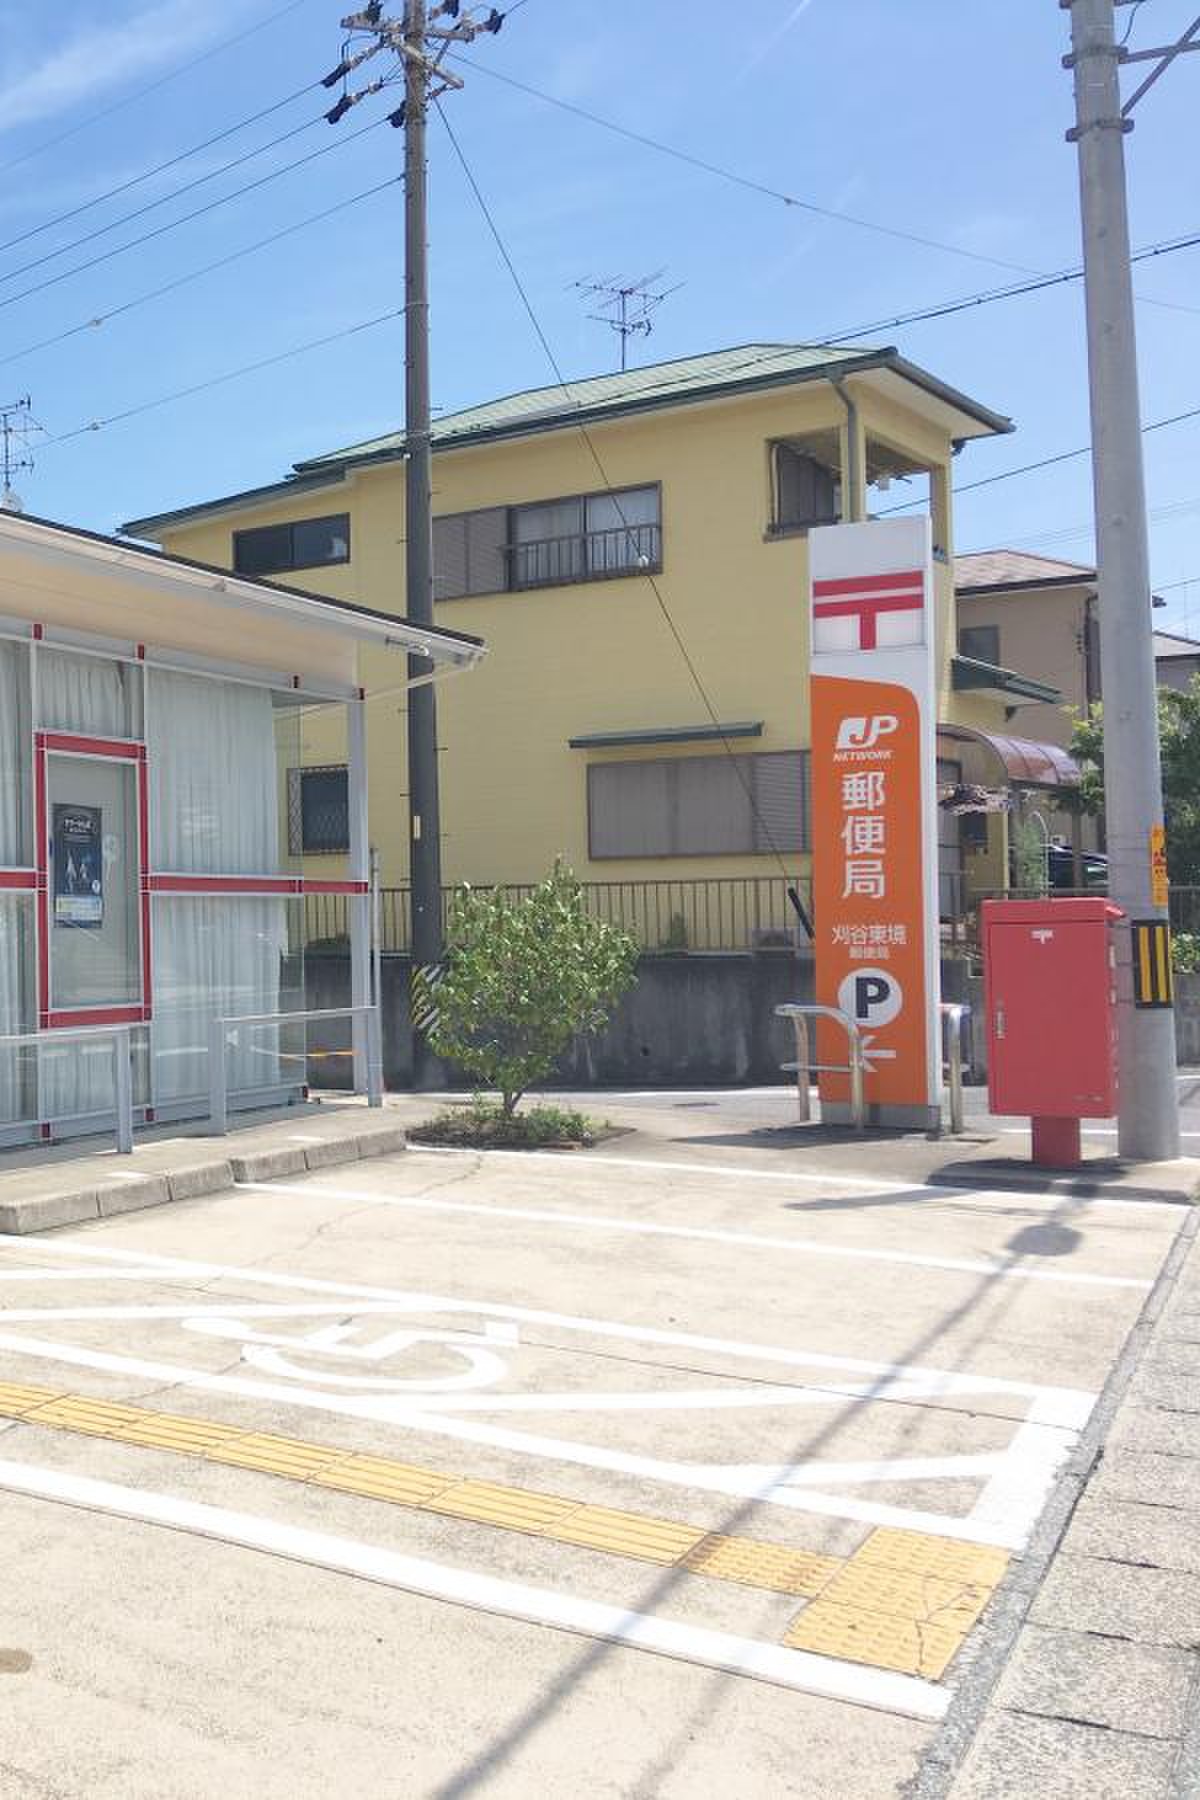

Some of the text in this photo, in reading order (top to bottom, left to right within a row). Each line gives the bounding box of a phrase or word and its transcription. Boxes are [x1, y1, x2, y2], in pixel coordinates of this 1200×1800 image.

[835, 715, 899, 750] JP
[833, 750, 893, 762] NETWORK
[841, 771, 885, 898] 郵便局
[855, 976, 890, 1018] P
